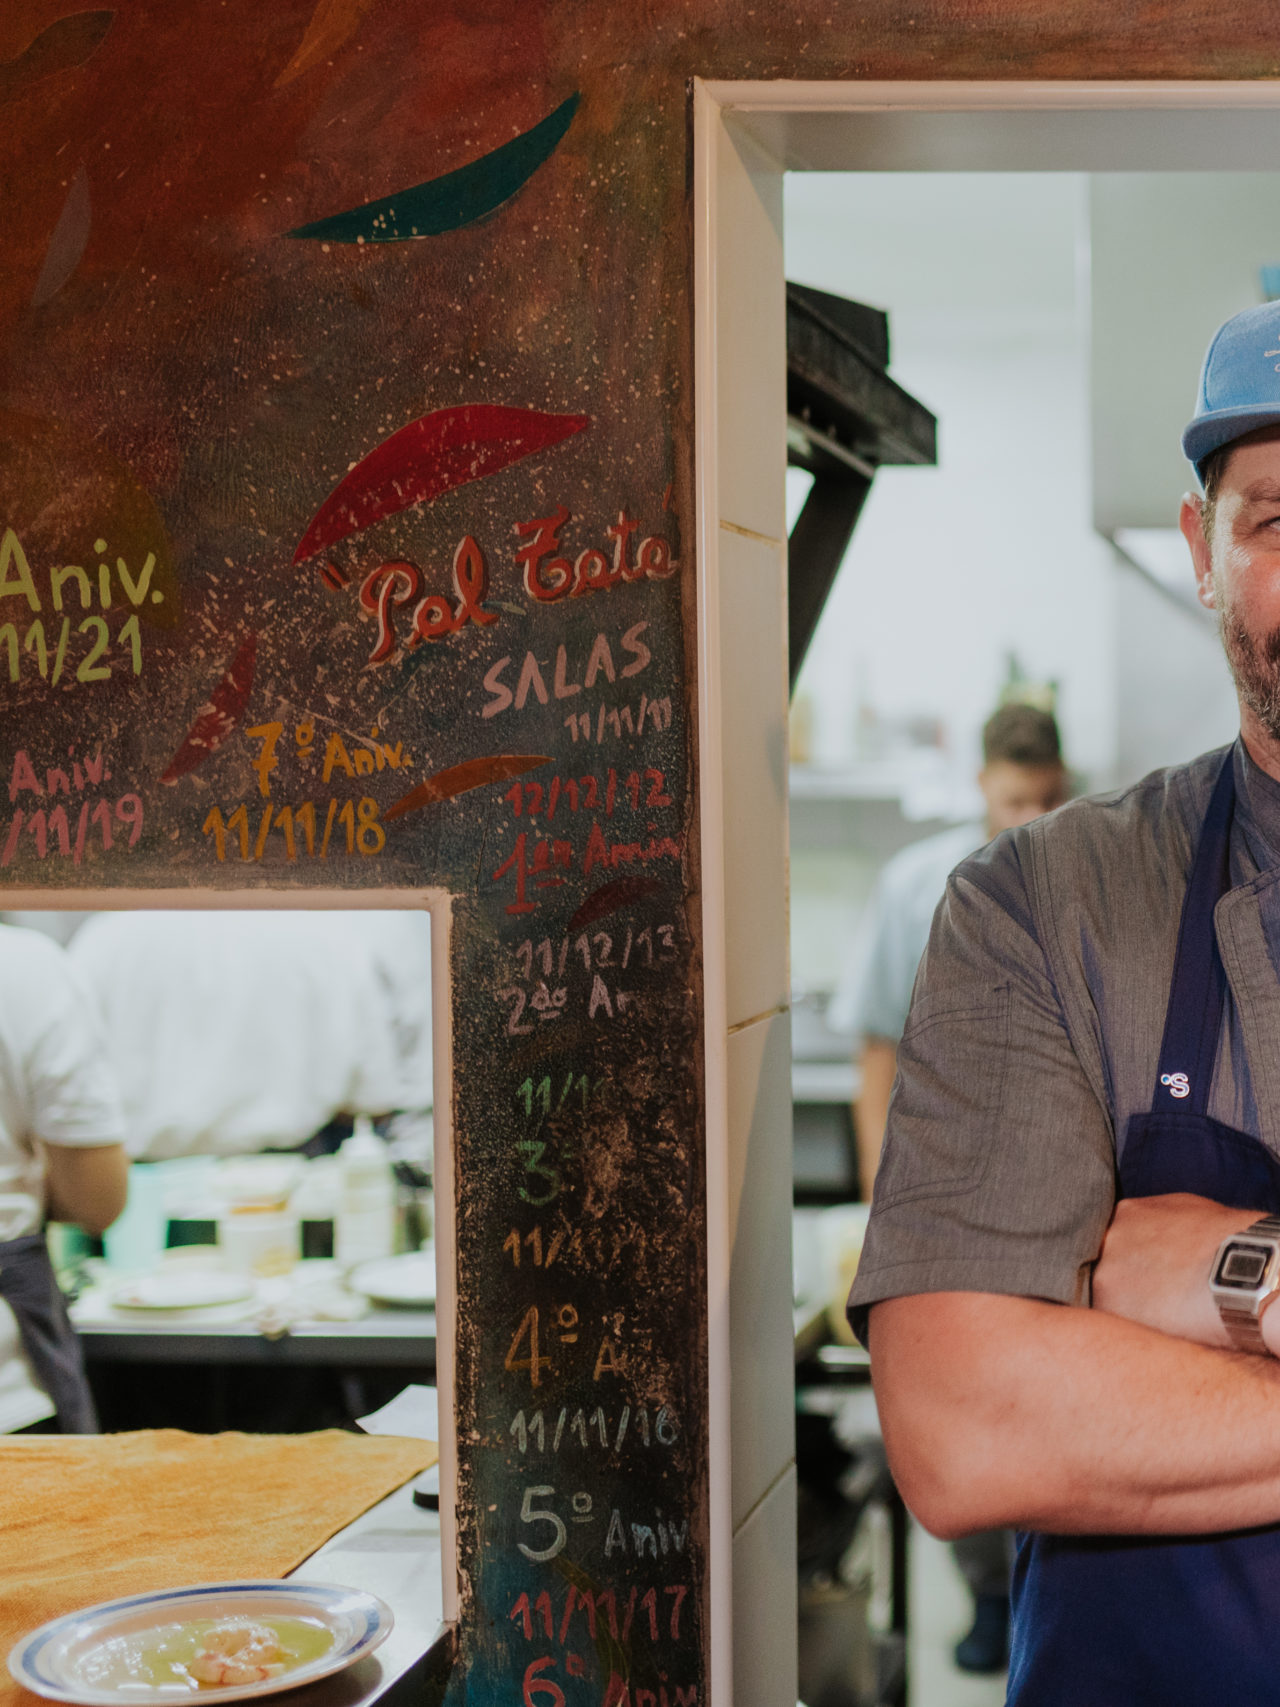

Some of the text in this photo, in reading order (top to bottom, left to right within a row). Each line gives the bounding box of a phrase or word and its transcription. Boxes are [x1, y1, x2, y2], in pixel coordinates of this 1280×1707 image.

[481, 621, 652, 719] SALAS
[505, 768, 673, 821] 12/12/12
[202, 798, 386, 862] 11/11/18
[510, 1585, 688, 1645] 11/11/17
